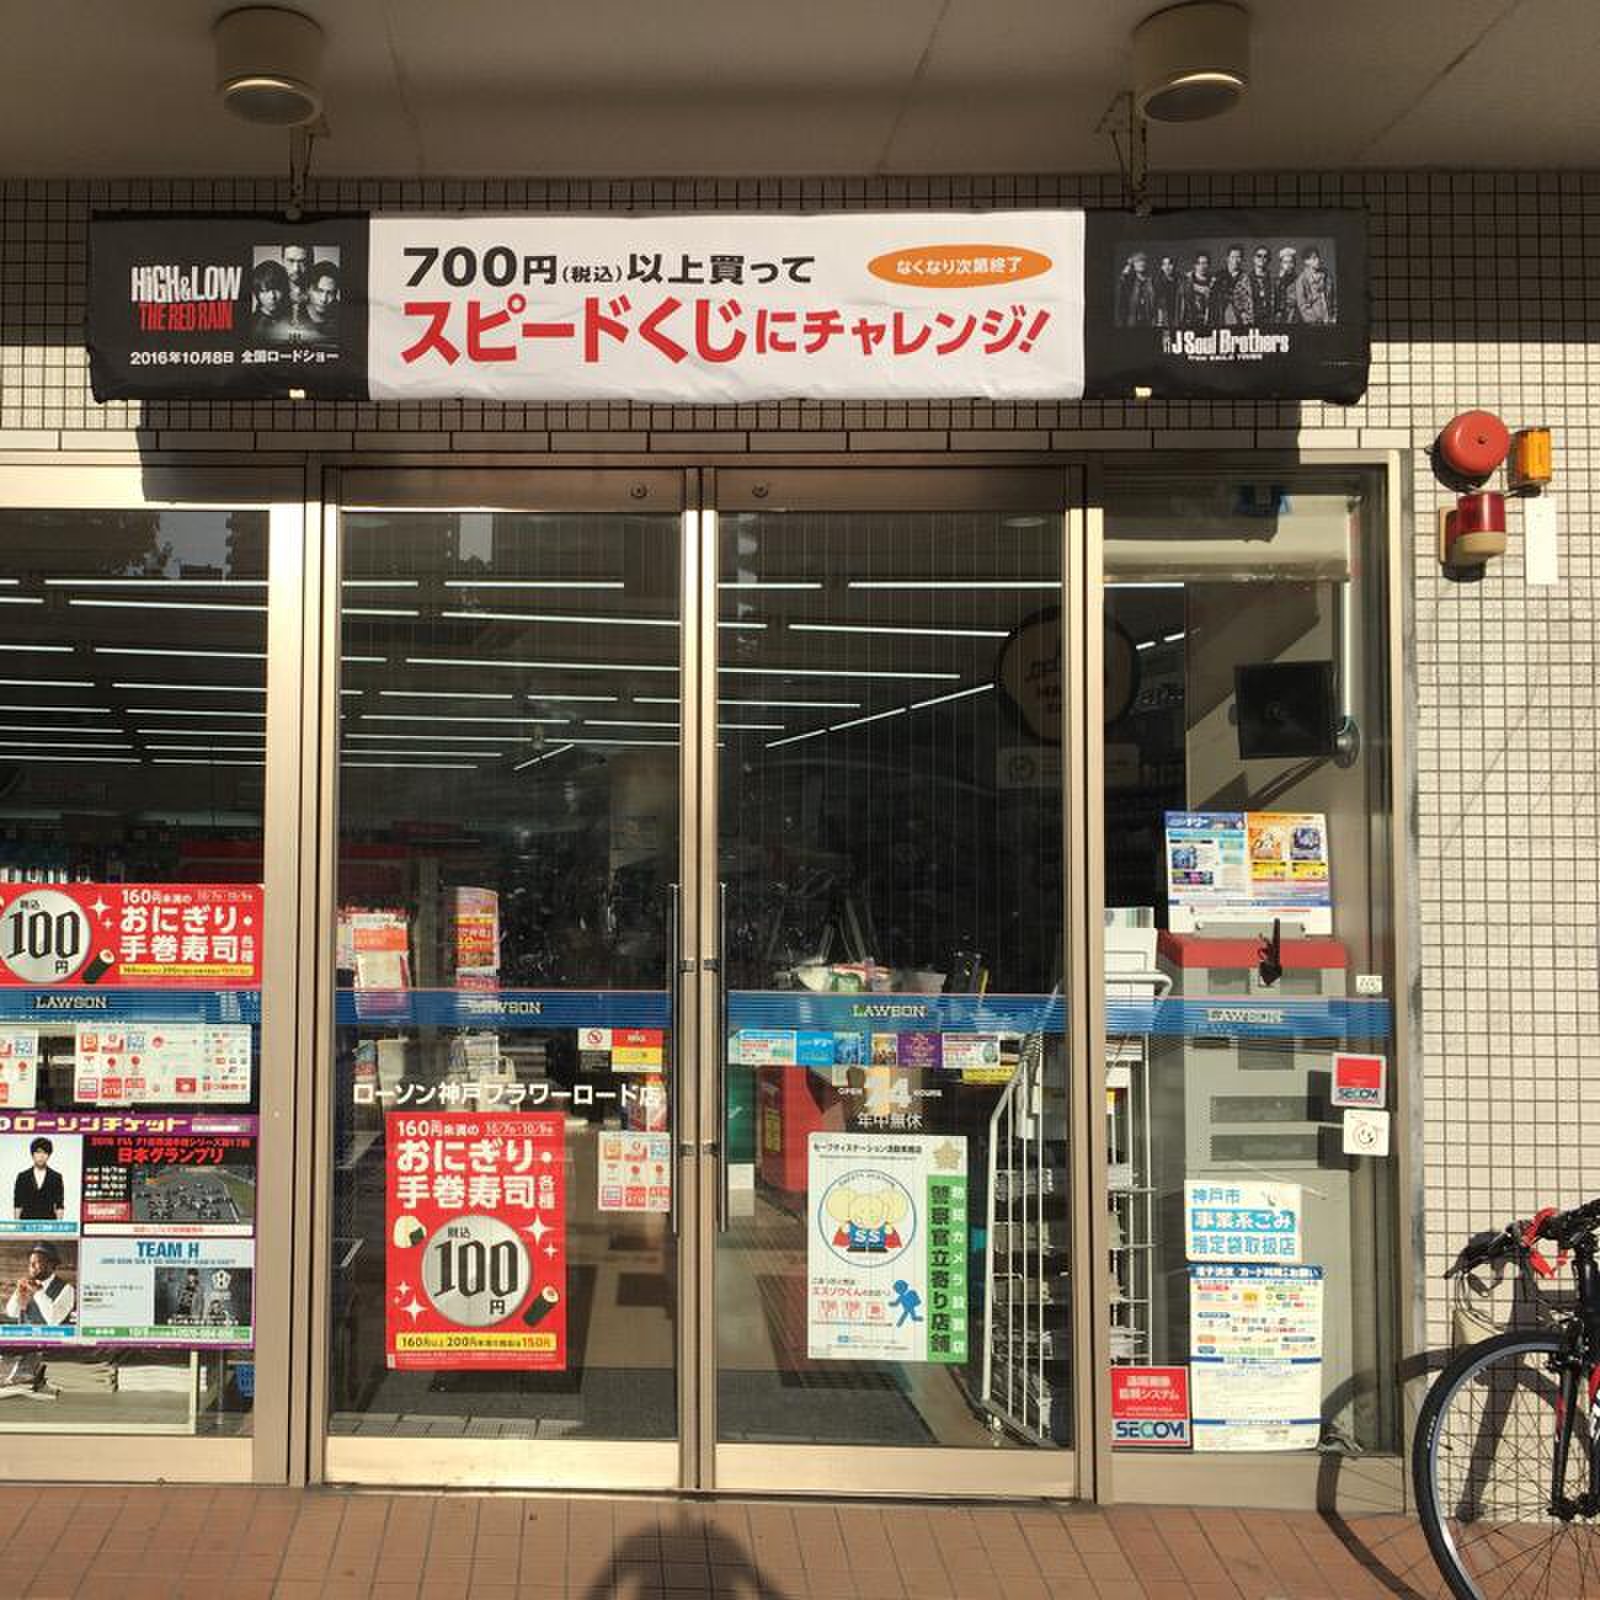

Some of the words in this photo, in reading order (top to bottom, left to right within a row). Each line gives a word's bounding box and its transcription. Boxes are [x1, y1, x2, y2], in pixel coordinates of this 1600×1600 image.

[896, 254, 1023, 276] なくなり次第終了
[139, 302, 166, 331] THE
[167, 302, 198, 331] RED
[199, 302, 233, 331] RAIN
[1171, 330, 1183, 354] J
[1184, 329, 1217, 355] Soul
[1219, 328, 1289, 354] Brothers
[130, 350, 234, 366] 2016年10月8日
[241, 348, 340, 364] 全国ロードショー
[6, 910, 81, 960] 100
[120, 934, 238, 963] 手巻寿司
[55, 960, 69, 974] 円
[35, 995, 107, 1009] LAWSON
[852, 1005, 927, 1018] LAWSON
[353, 1081, 665, 1106] ローソン神戸フラワーロード店
[1338, 1088, 1379, 1100] SECOM
[857, 1112, 923, 1129] 年中無休
[117, 1148, 225, 1164] 日本グランプリ
[396, 1174, 536, 1209] 手巻寿司
[1192, 1188, 1241, 1205] 神戸市
[136, 1241, 182, 1258] TEAM
[188, 1241, 200, 1258] H
[1192, 1236, 1295, 1255] 指定袋取扱店
[433, 1239, 519, 1298] 100
[489, 1300, 506, 1315] 円
[1115, 1421, 1185, 1439] SECOM
